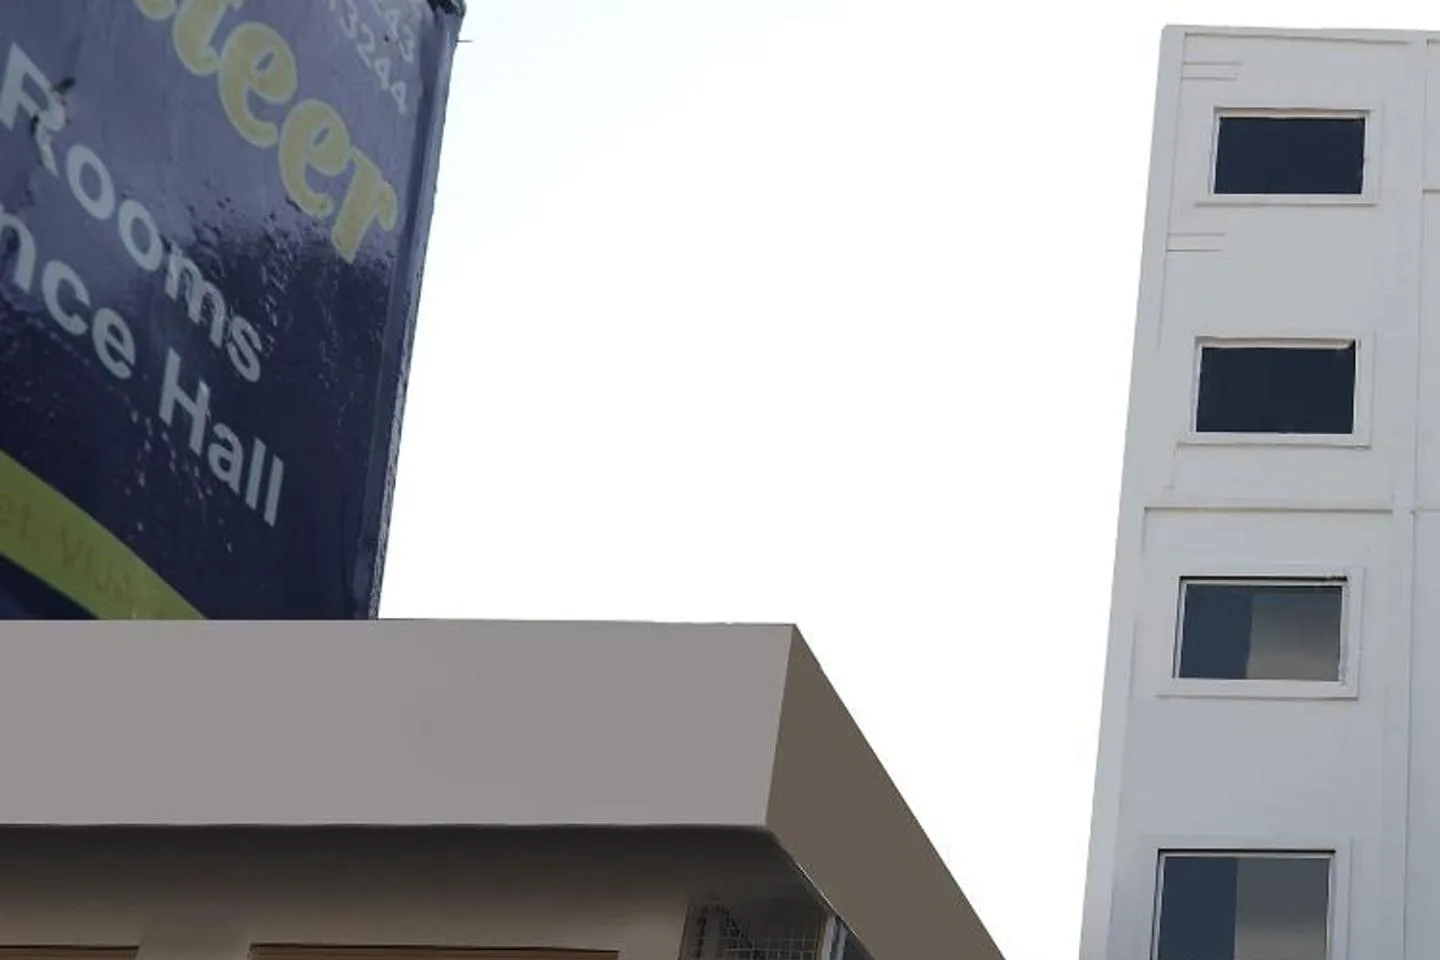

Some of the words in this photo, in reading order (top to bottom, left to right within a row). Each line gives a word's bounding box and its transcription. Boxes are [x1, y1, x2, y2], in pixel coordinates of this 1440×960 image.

[0, 42, 262, 383] Rooms
[132, 0, 398, 264] teer
[158, 348, 285, 528] Hall
